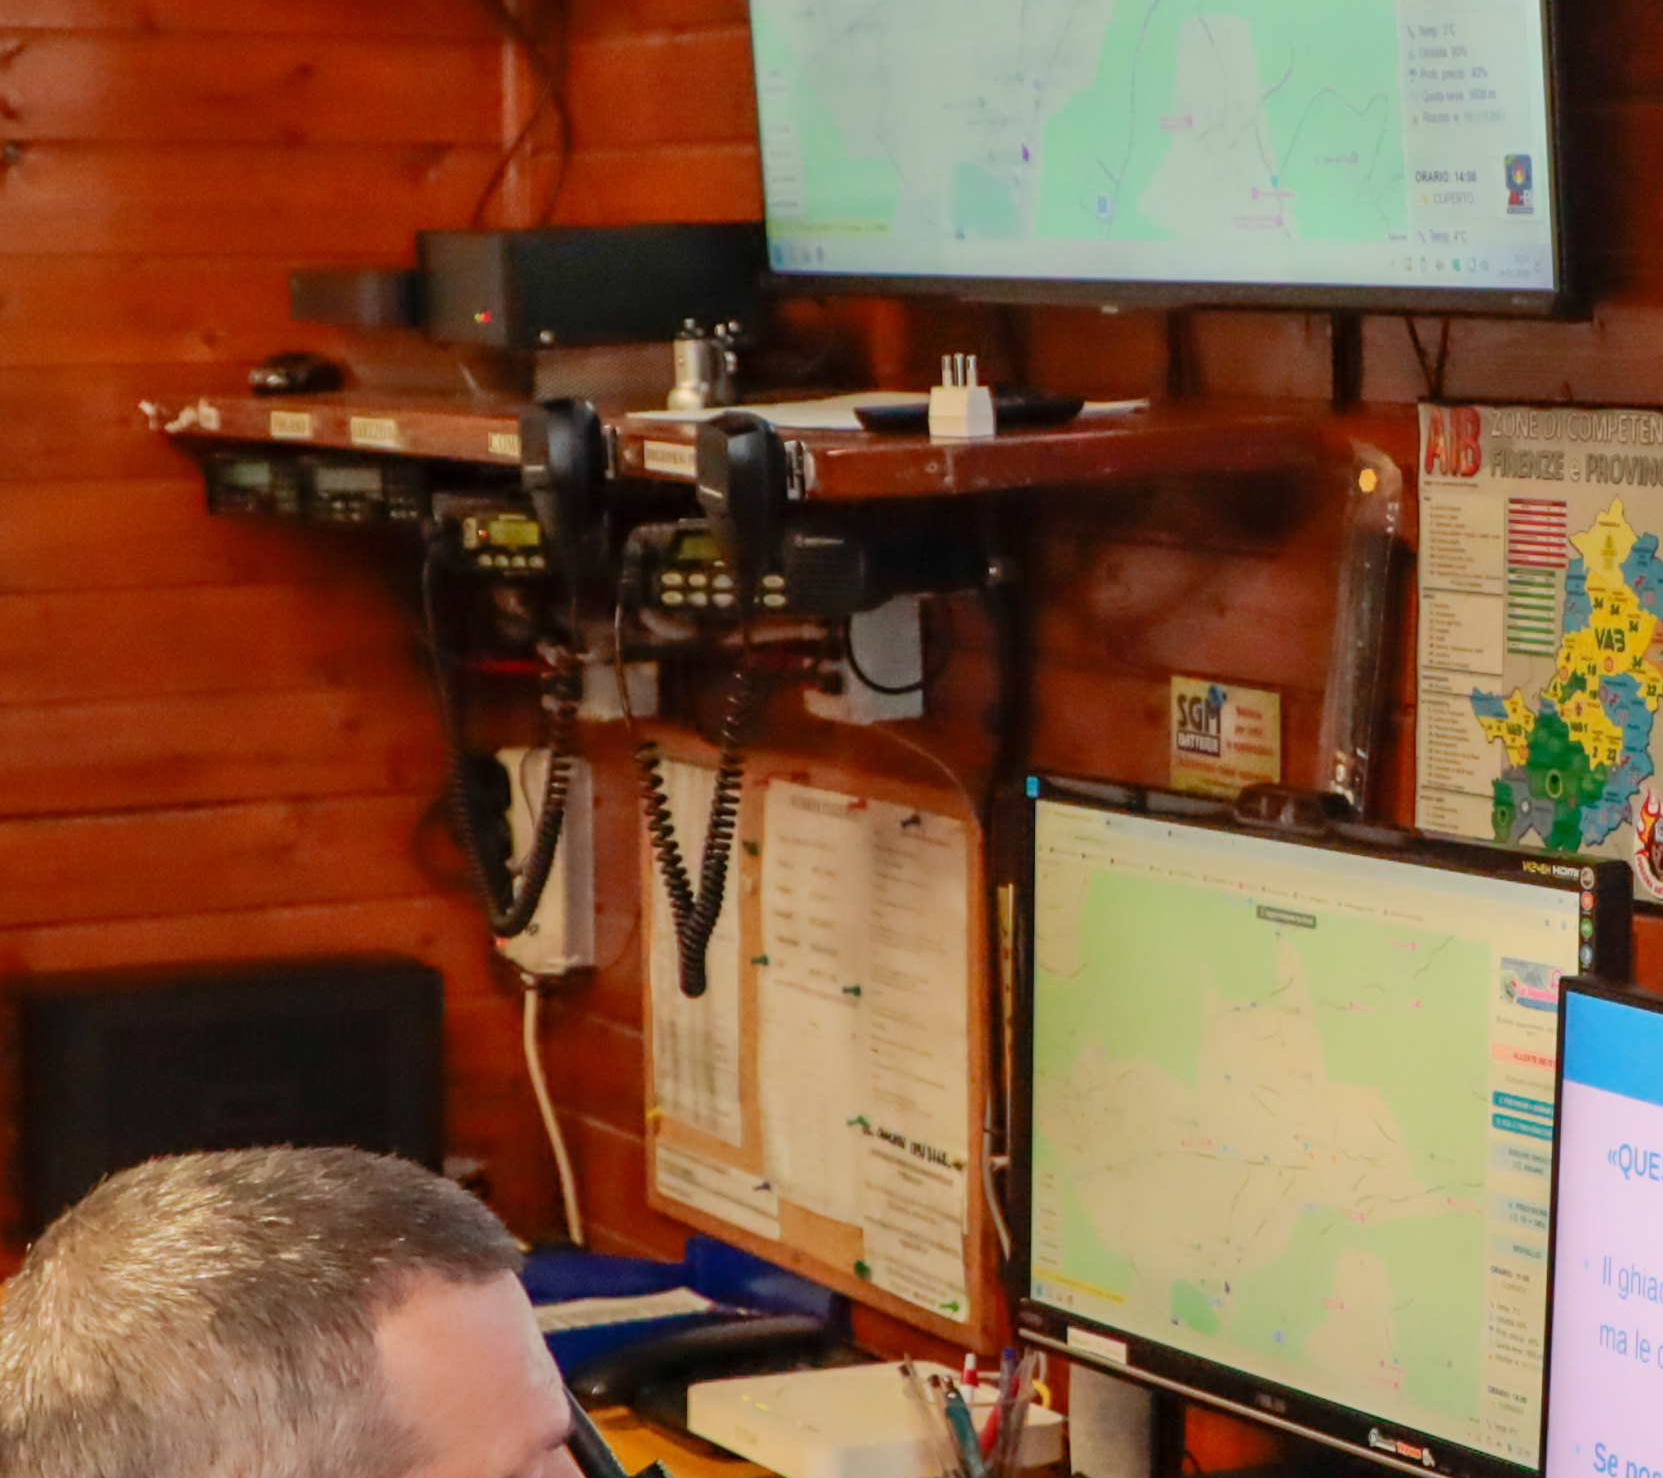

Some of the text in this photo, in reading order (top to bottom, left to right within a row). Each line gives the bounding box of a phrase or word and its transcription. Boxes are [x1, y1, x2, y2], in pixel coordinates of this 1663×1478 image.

[1424, 406, 1482, 477] AIB
[1491, 409, 1537, 438] ZONE
[1544, 413, 1562, 441] DI
[1489, 448, 1565, 481] FIRENZE
[1569, 460, 1581, 481] e
[1601, 1255, 1612, 1286] Il
[1599, 1319, 1628, 1354] ma
[1634, 1330, 1651, 1364] le
[1593, 1443, 1618, 1478] Se
